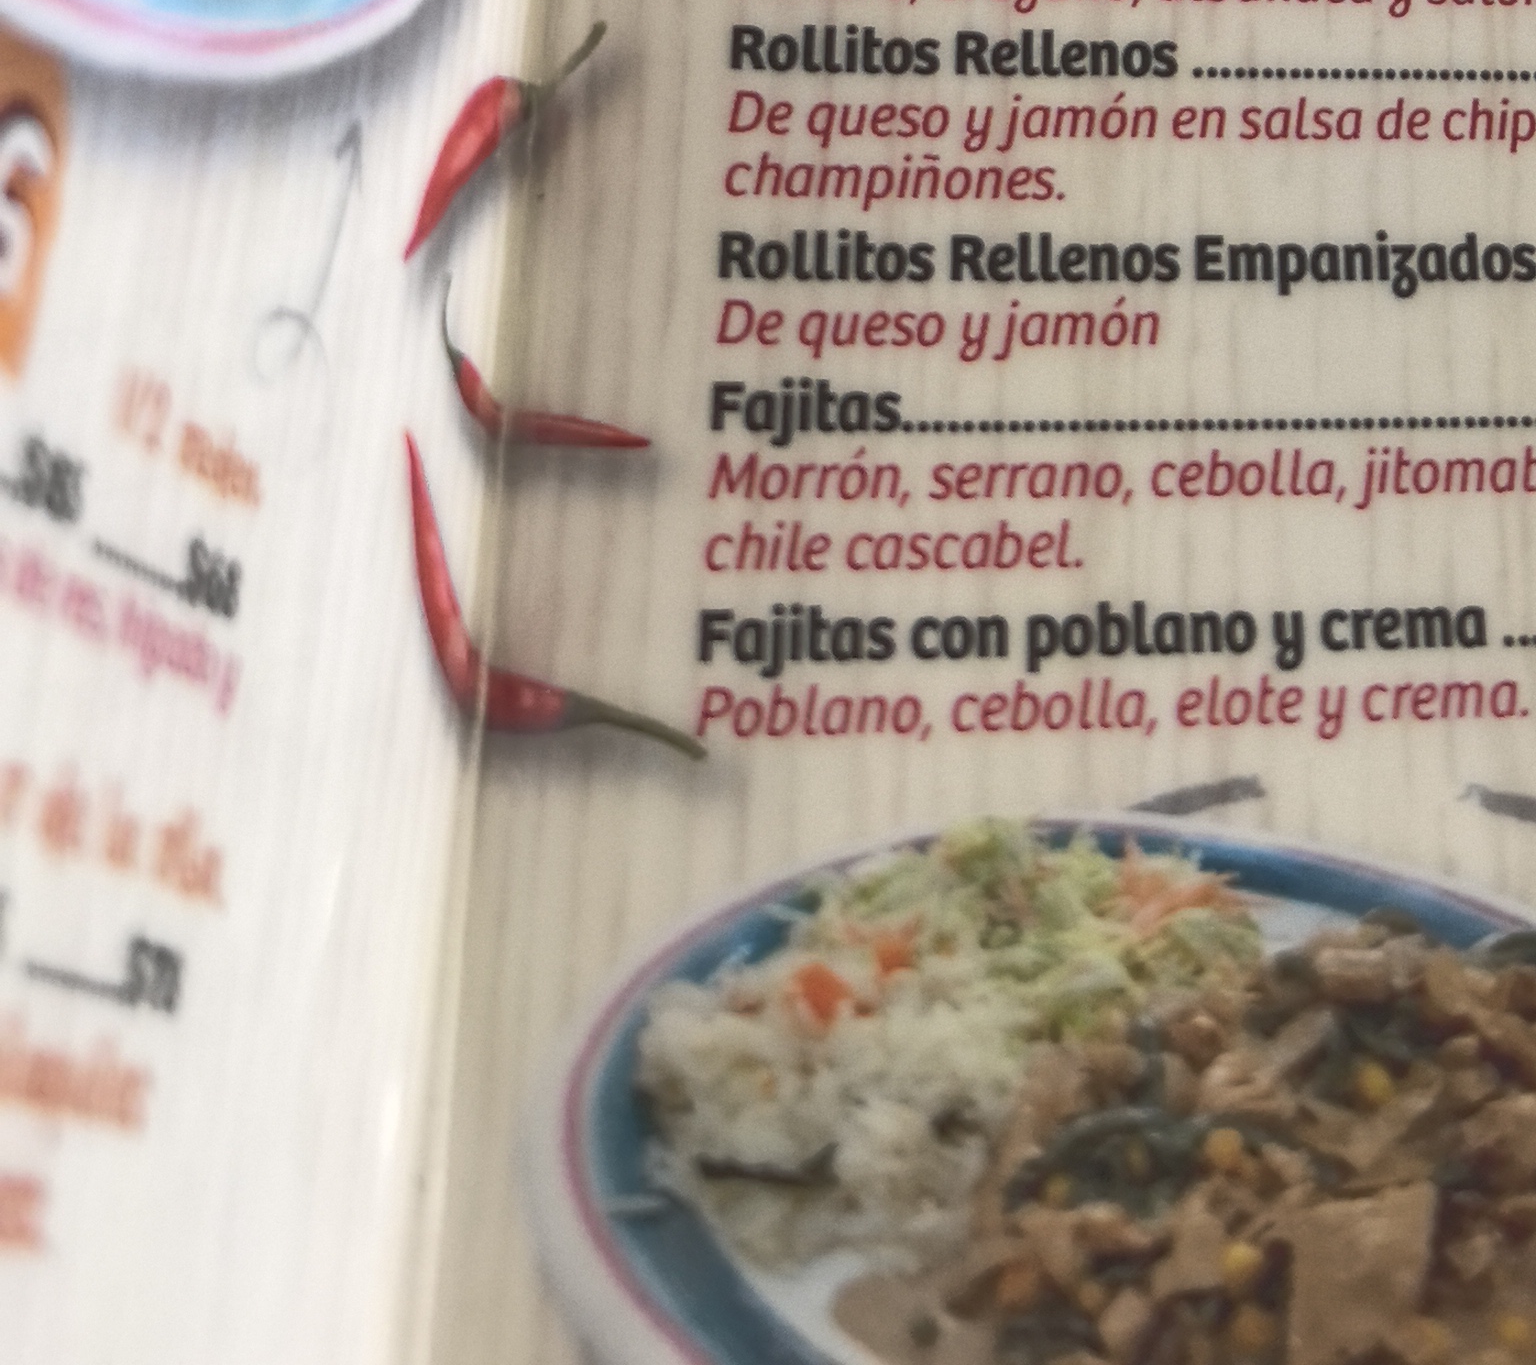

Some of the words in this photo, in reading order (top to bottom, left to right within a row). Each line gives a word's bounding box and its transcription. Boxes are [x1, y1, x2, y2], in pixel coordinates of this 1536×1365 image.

[715, 228, 937, 287] Rollitos
[947, 231, 1182, 288] Rellenos
[698, 606, 898, 673] Fajitas
[910, 610, 1009, 661] con
[1025, 602, 1259, 676] poblano
[1273, 618, 1307, 671] y
[1317, 605, 1490, 655] crema
[698, 686, 934, 743] Poblano,
[949, 677, 1158, 738] cebolla,
[1174, 679, 1302, 731] elote
[1315, 685, 1348, 743] y
[1359, 679, 1531, 724] crema.
